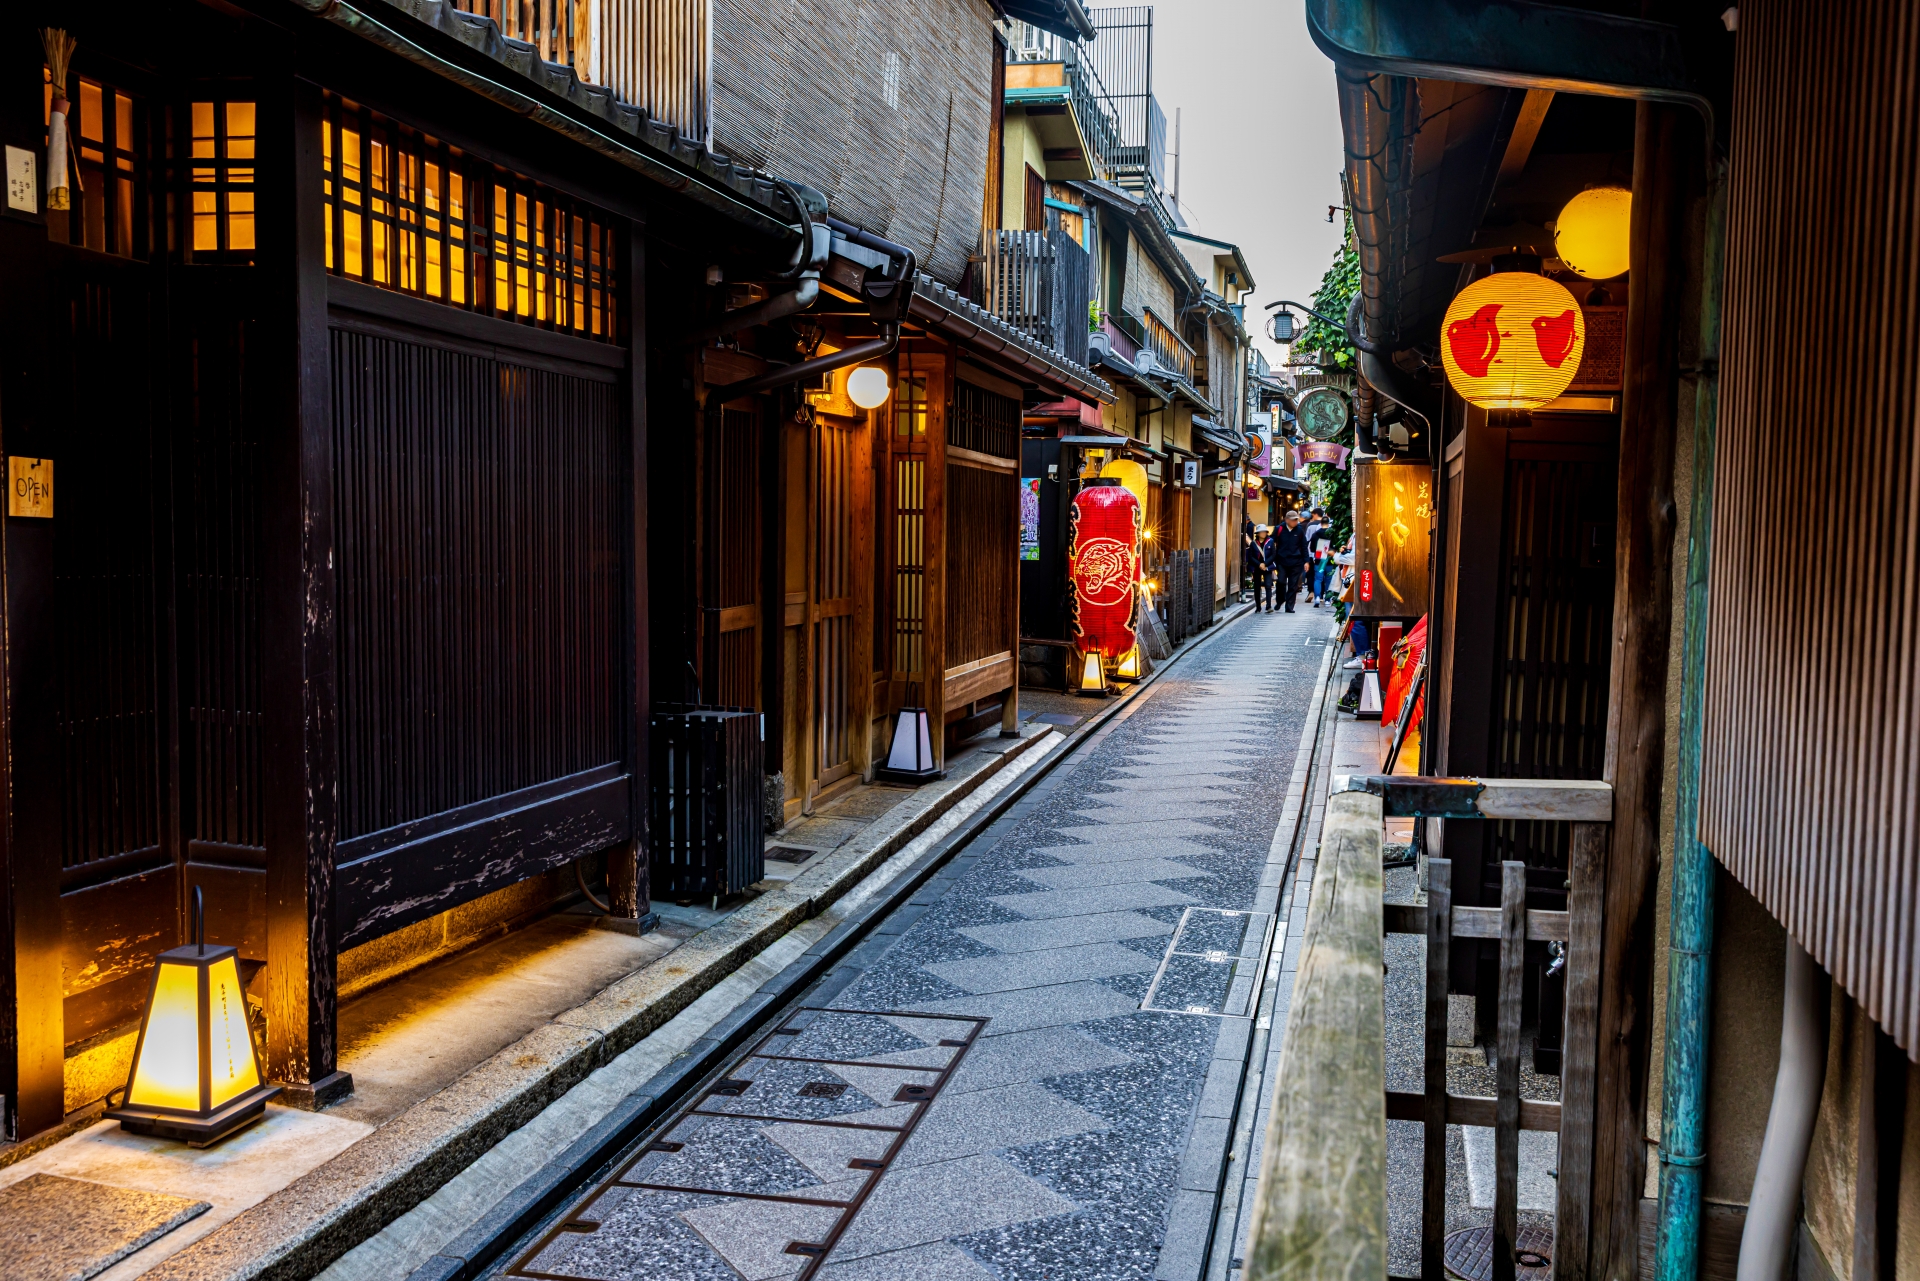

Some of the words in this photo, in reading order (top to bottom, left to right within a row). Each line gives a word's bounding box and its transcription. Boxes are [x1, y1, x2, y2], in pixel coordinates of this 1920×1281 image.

[1297, 375, 1325, 390] HELLO
[1303, 450, 1338, 460] ハロードーリィ
[16, 477, 49, 502] OPEN
